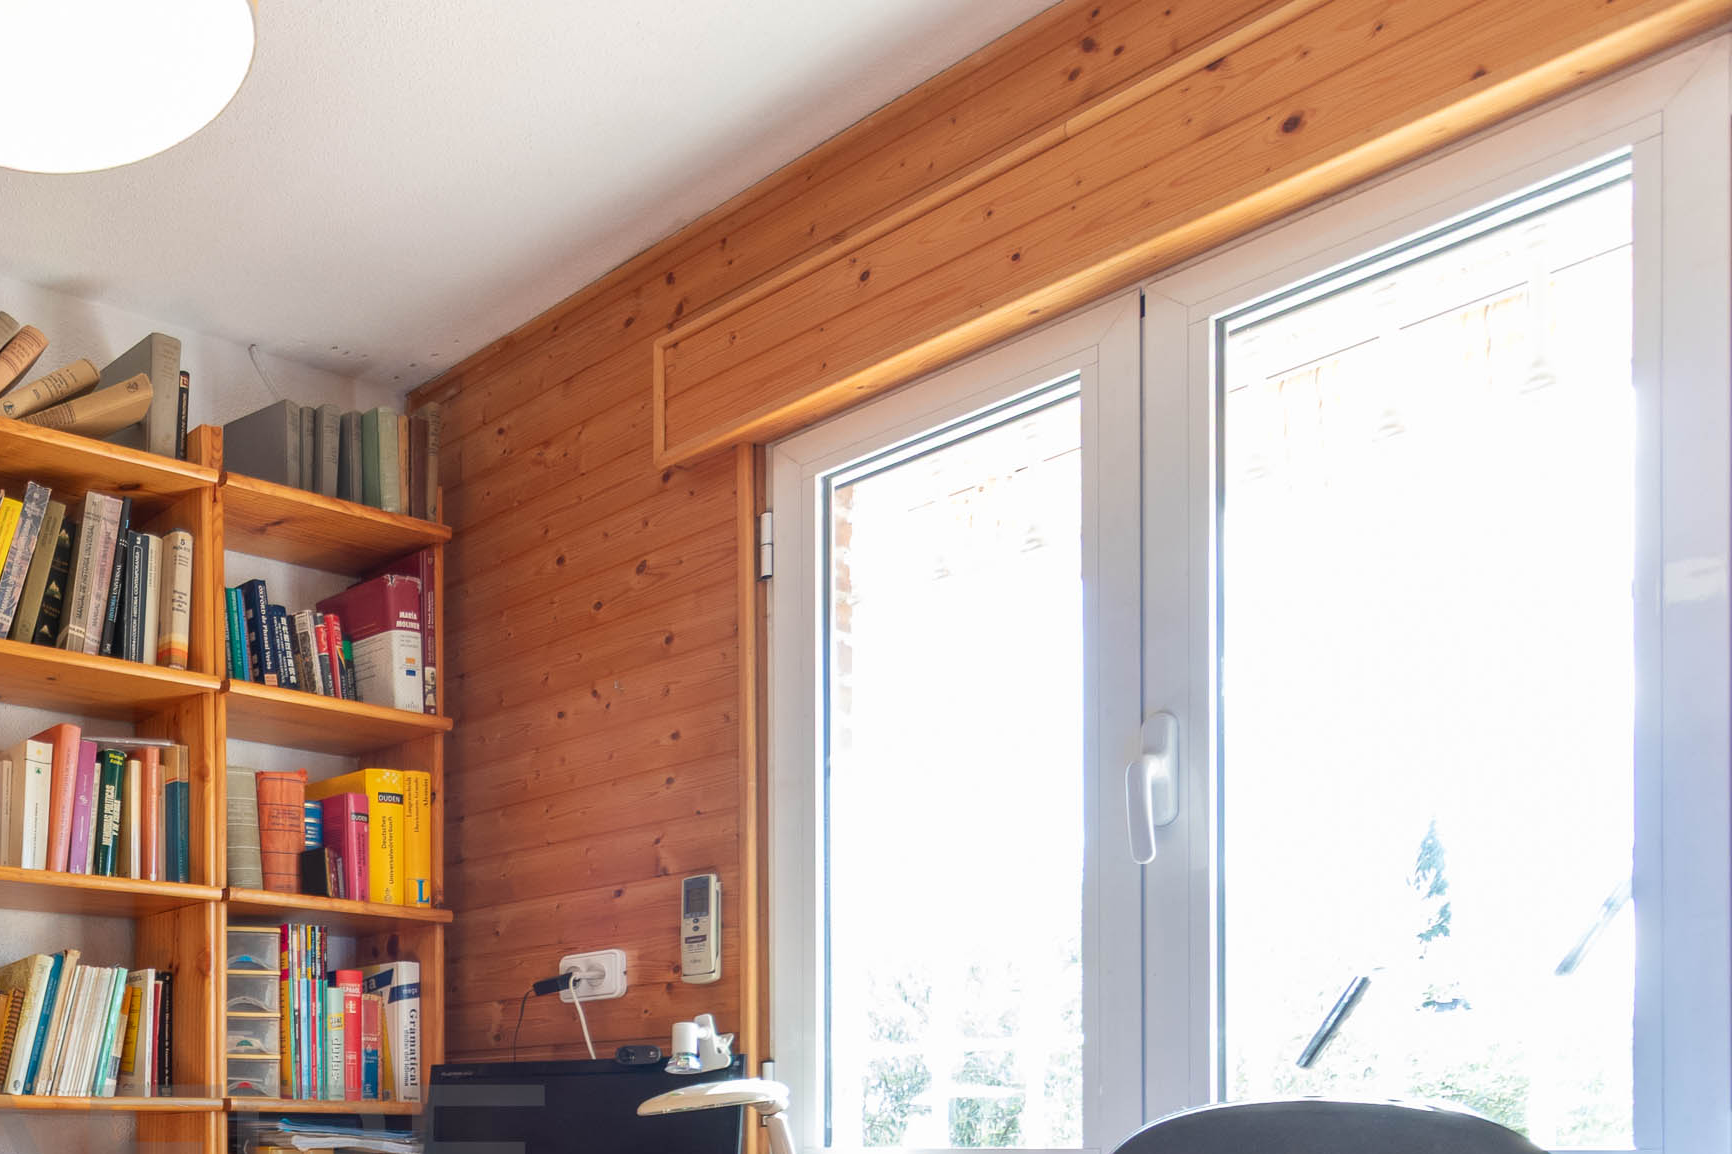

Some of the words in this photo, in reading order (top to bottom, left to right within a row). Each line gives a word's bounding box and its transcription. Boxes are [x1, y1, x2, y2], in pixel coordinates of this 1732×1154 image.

[258, 584, 266, 616] OXFORD
[378, 794, 401, 804] DUDEN
[409, 1007, 419, 1087] Gramatical
